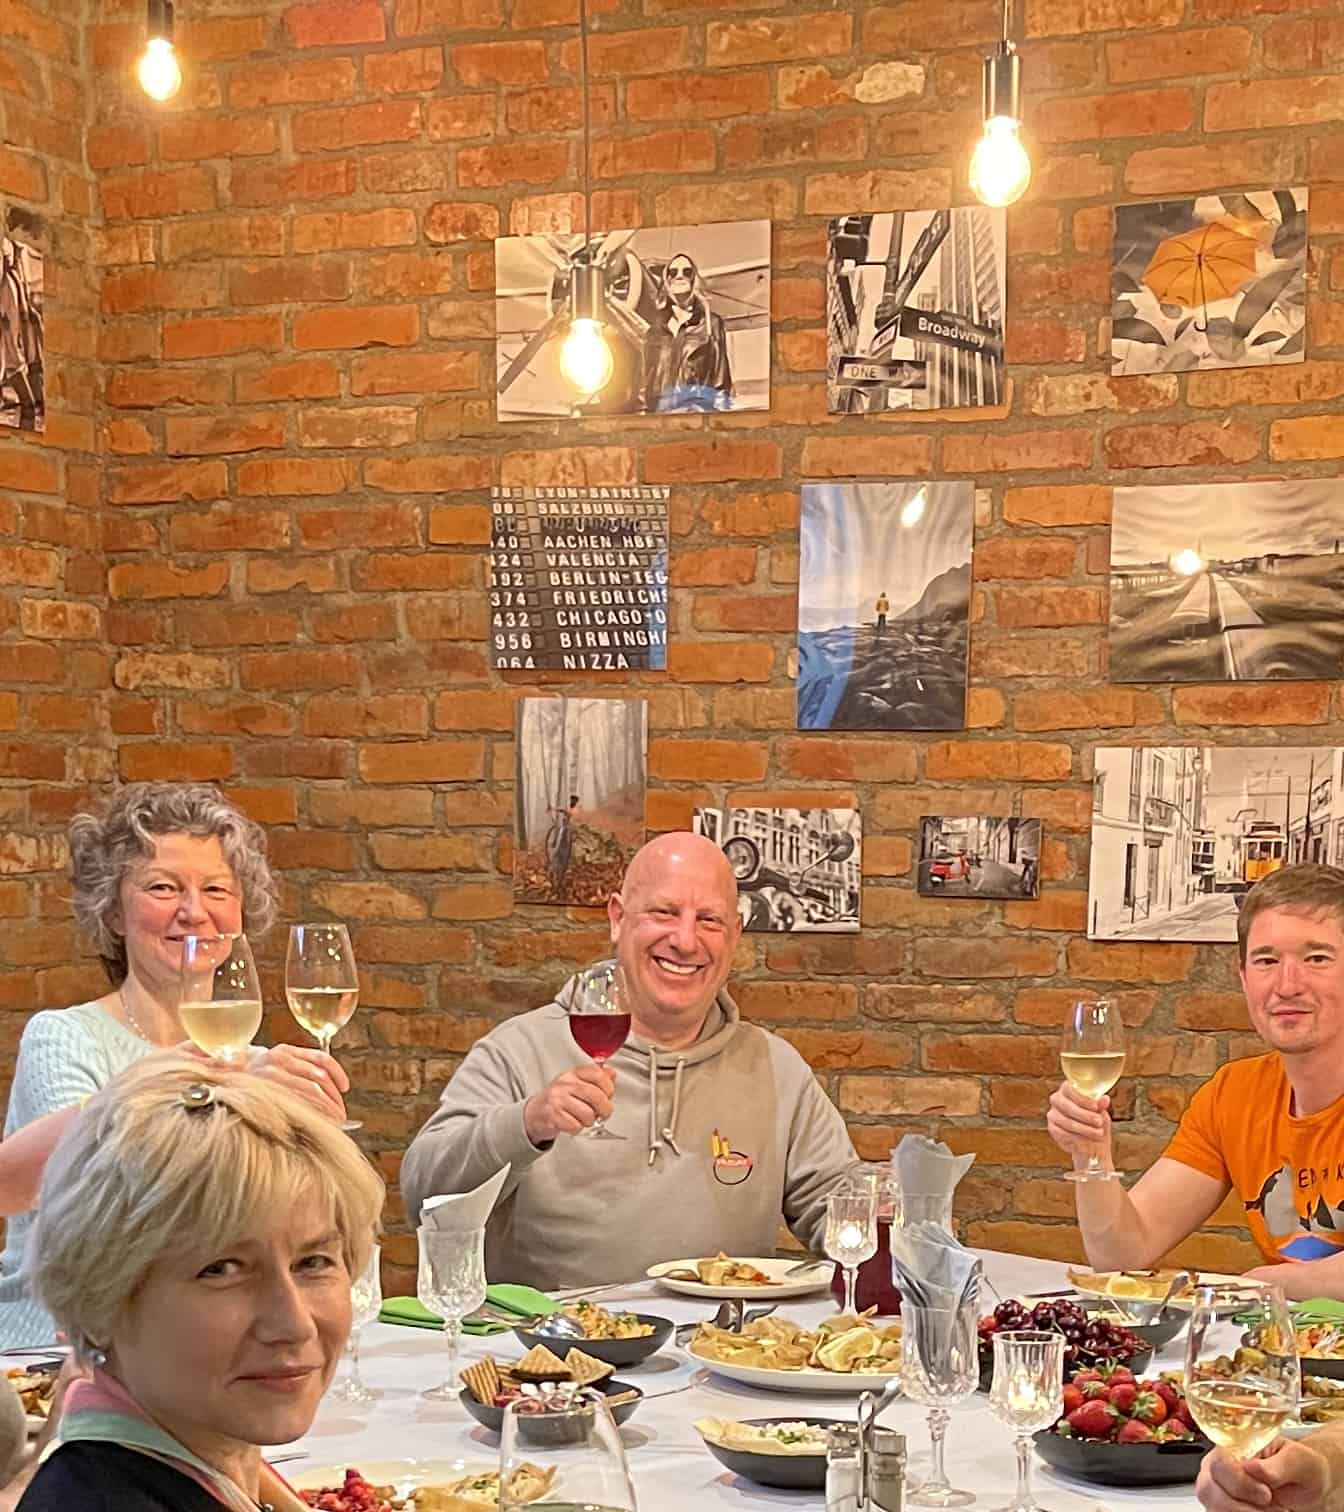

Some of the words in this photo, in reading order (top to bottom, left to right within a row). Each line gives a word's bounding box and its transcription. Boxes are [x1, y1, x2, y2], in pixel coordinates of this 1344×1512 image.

[918, 317, 986, 348] Broadway
[851, 366, 877, 379] ONE
[544, 535, 612, 548] AACHEN
[546, 553, 640, 567] VALENCIA
[490, 591, 526, 607] 374
[493, 612, 529, 627] 432
[563, 653, 629, 669] NIZZA
